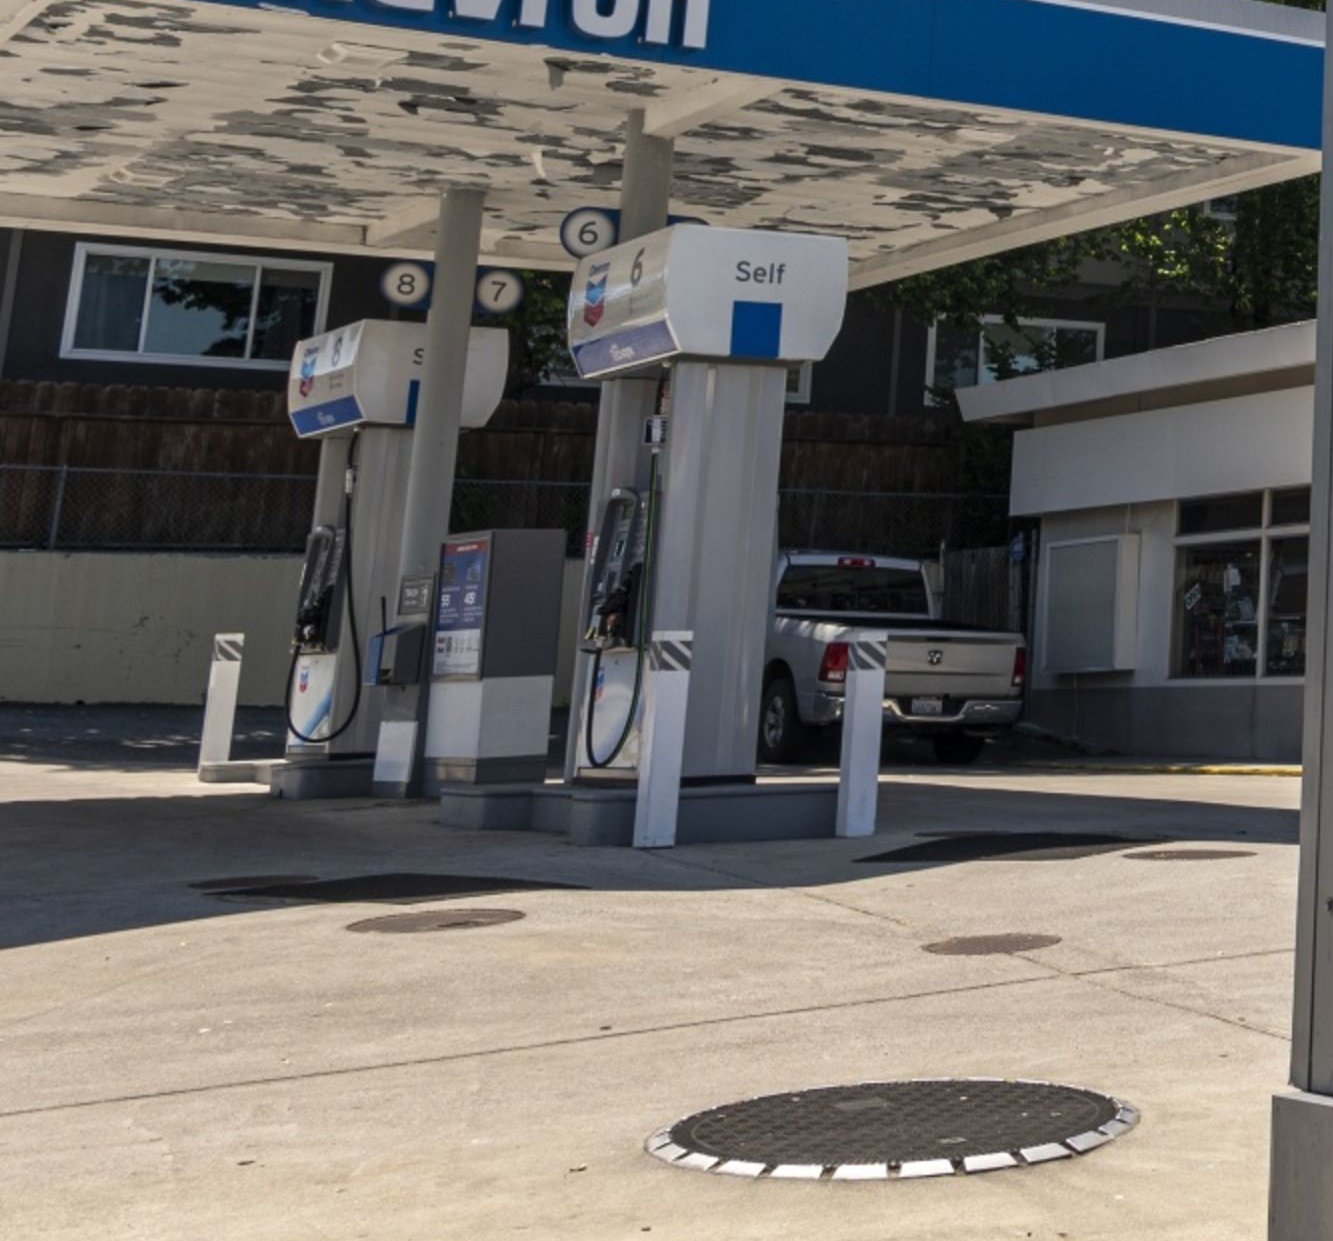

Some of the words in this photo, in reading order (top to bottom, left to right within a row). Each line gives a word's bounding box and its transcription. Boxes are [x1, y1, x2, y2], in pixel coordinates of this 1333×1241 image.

[577, 220, 598, 245] 6
[630, 246, 646, 287] 6
[735, 260, 787, 285] Self
[396, 273, 416, 297] 8
[490, 281, 507, 302] 7
